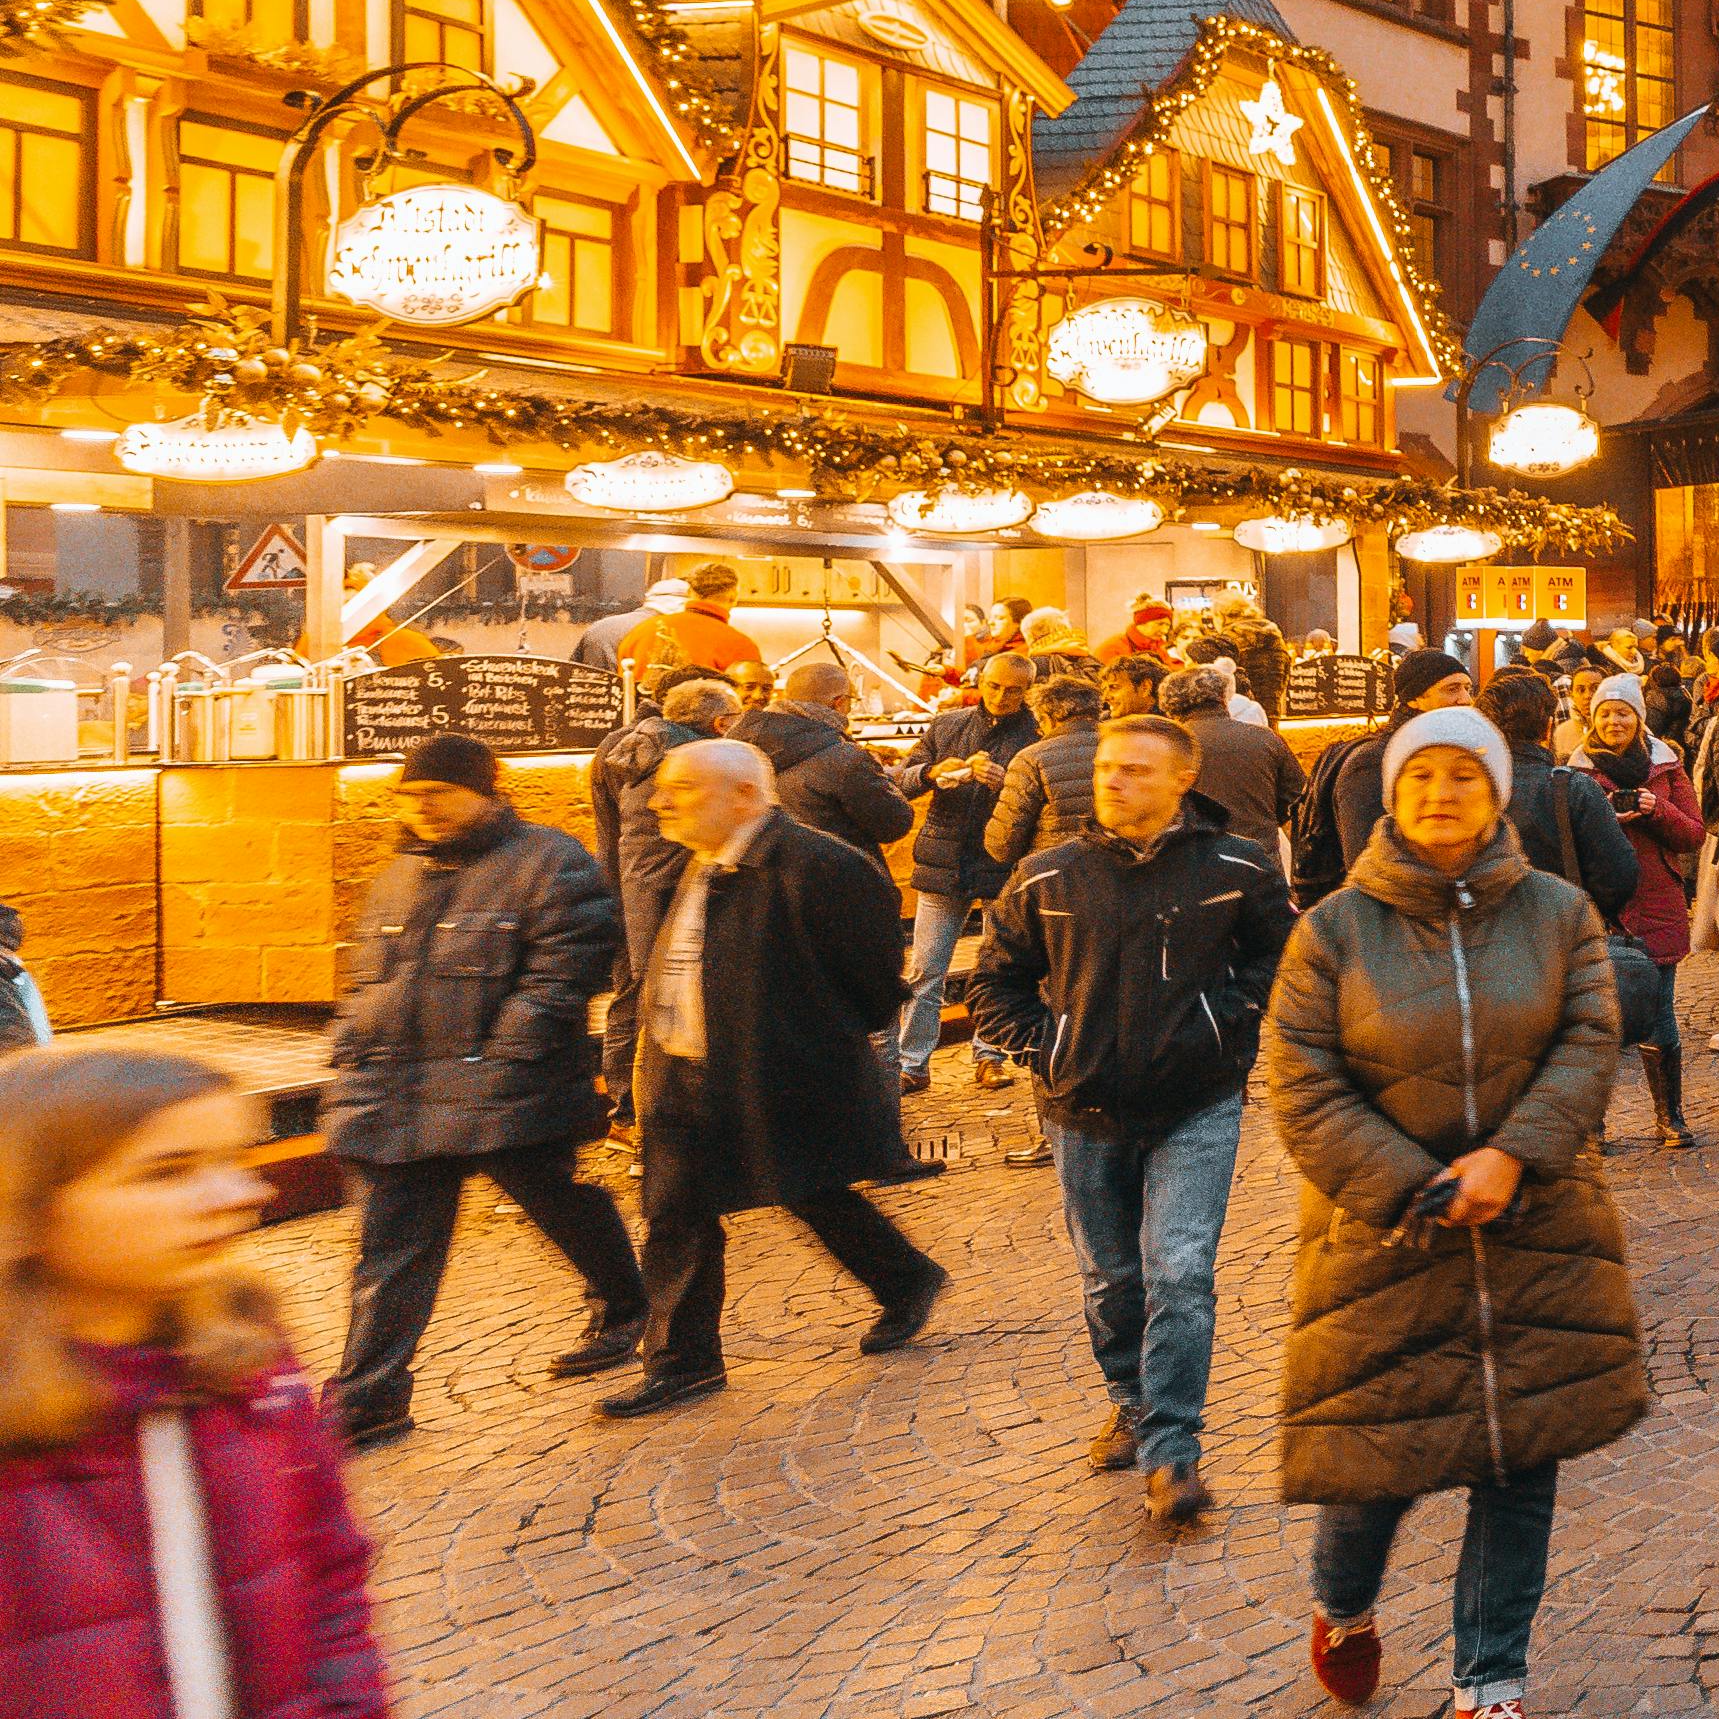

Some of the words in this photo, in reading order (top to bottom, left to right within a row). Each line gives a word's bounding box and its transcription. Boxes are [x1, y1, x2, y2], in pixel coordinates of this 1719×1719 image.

[1462, 577, 1481, 587] ATM
[1512, 577, 1531, 587] ATM
[1548, 577, 1573, 587] ATM
